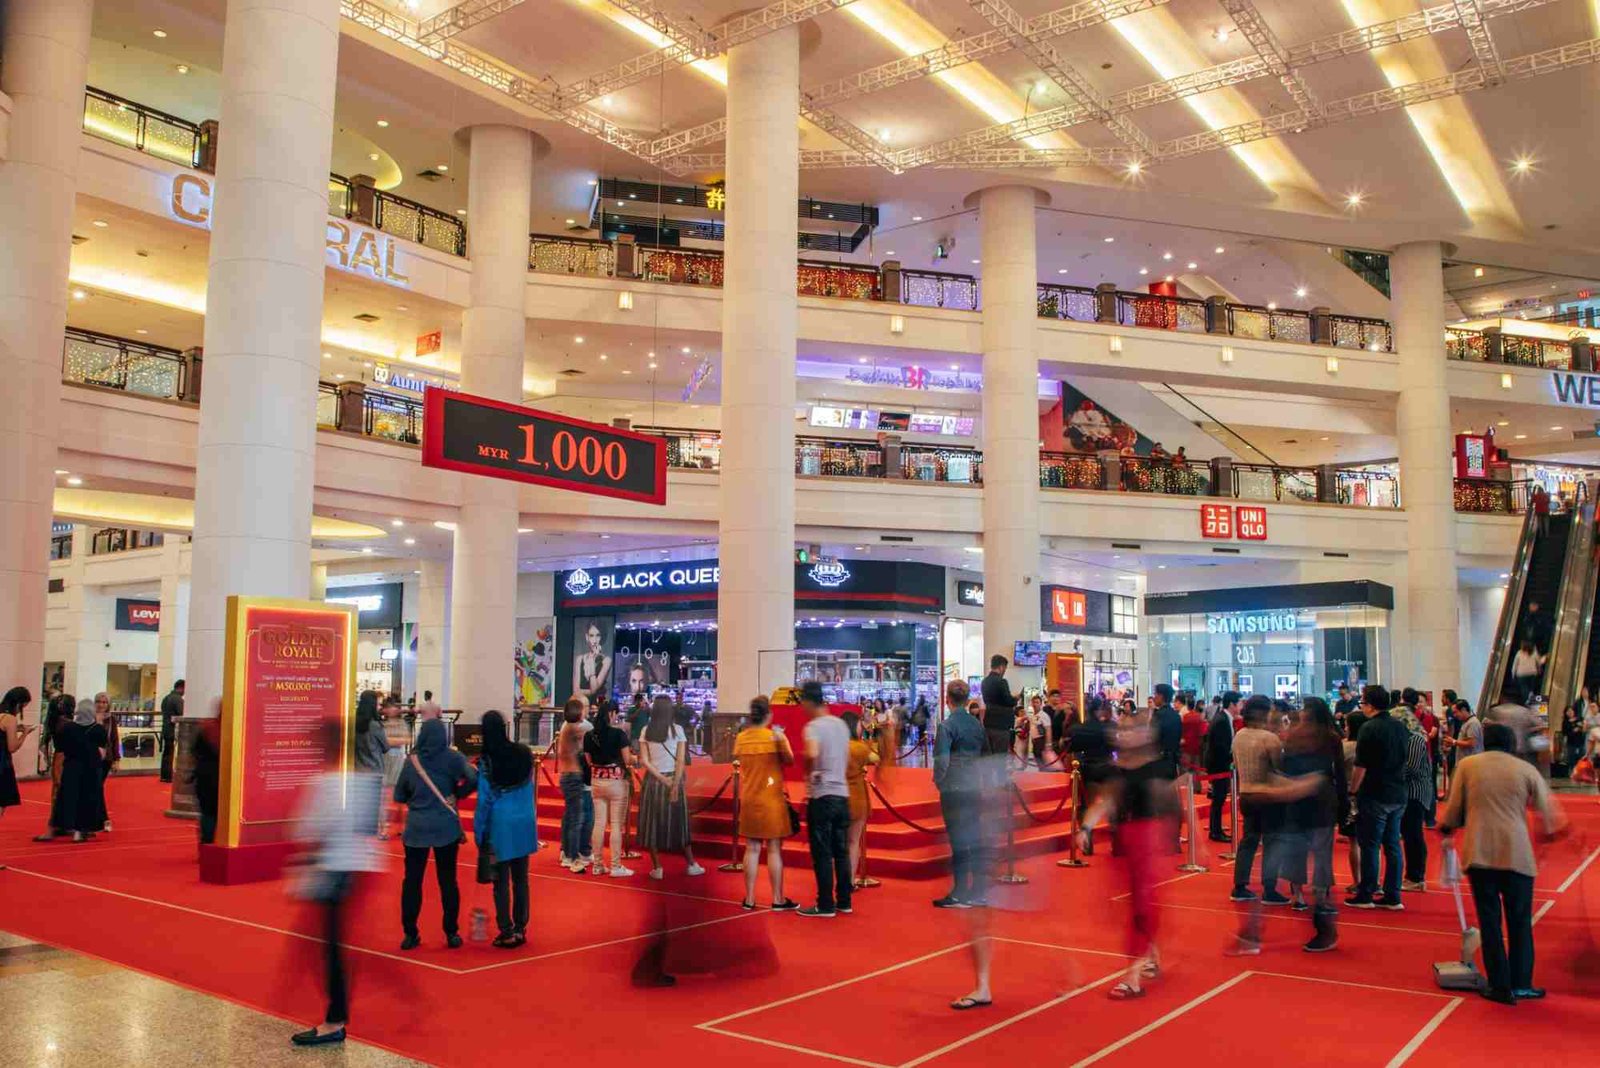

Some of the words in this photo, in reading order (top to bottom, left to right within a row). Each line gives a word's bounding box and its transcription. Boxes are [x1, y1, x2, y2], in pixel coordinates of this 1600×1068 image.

[172, 173, 409, 284] CRAL
[477, 444, 509, 460] MYR
[517, 423, 628, 481] 1,000
[599, 571, 663, 590] BLACK
[1206, 613, 1297, 634] SAMSUNG
[274, 645, 324, 659] ROYALE
